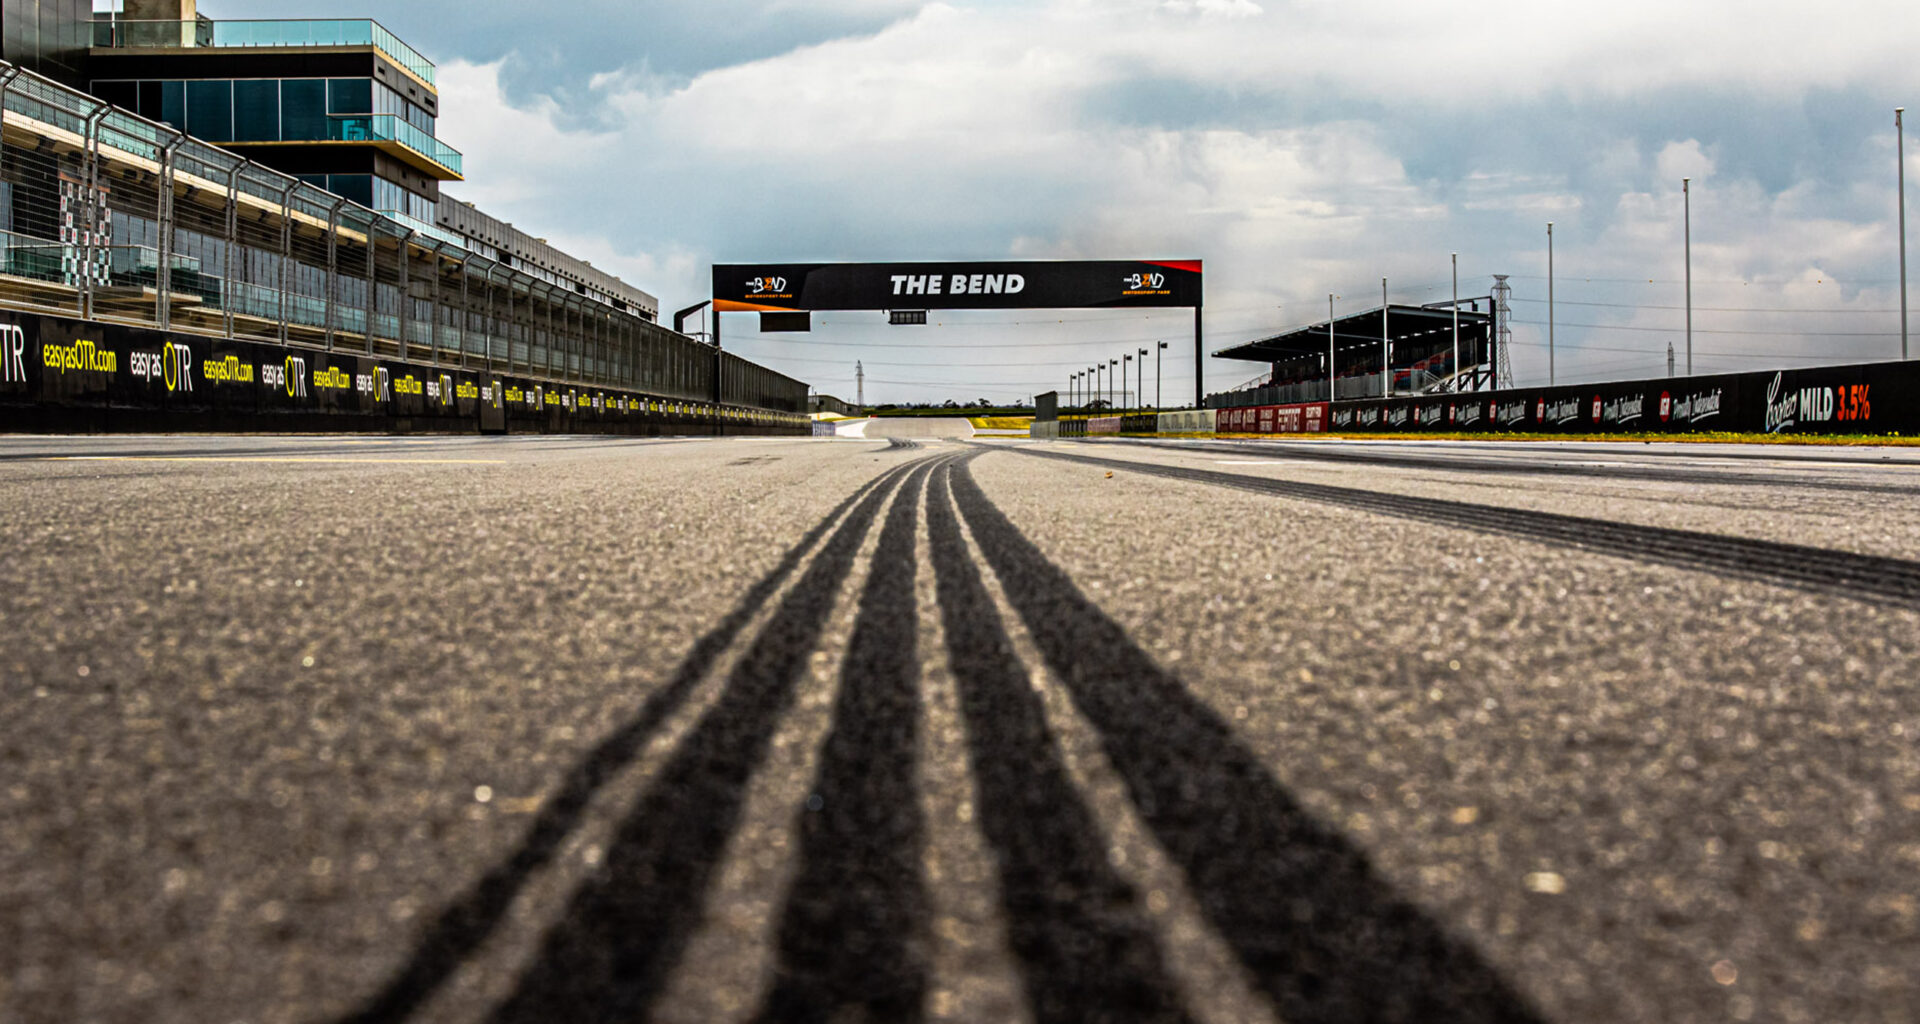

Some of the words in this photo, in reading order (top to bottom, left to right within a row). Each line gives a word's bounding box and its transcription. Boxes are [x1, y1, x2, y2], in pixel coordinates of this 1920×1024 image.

[890, 274, 943, 295] THE
[949, 273, 1025, 294] BEND
[0, 323, 27, 383] TR
[43, 339, 117, 375] easyasOTR.com
[130, 351, 151, 383] easy
[151, 353, 162, 377] as
[163, 341, 193, 392] OTR
[203, 355, 254, 385] easyasOTR.com
[285, 355, 307, 398] OTR
[1800, 387, 1833, 421] MILD
[1837, 384, 1871, 421] 3.5%
